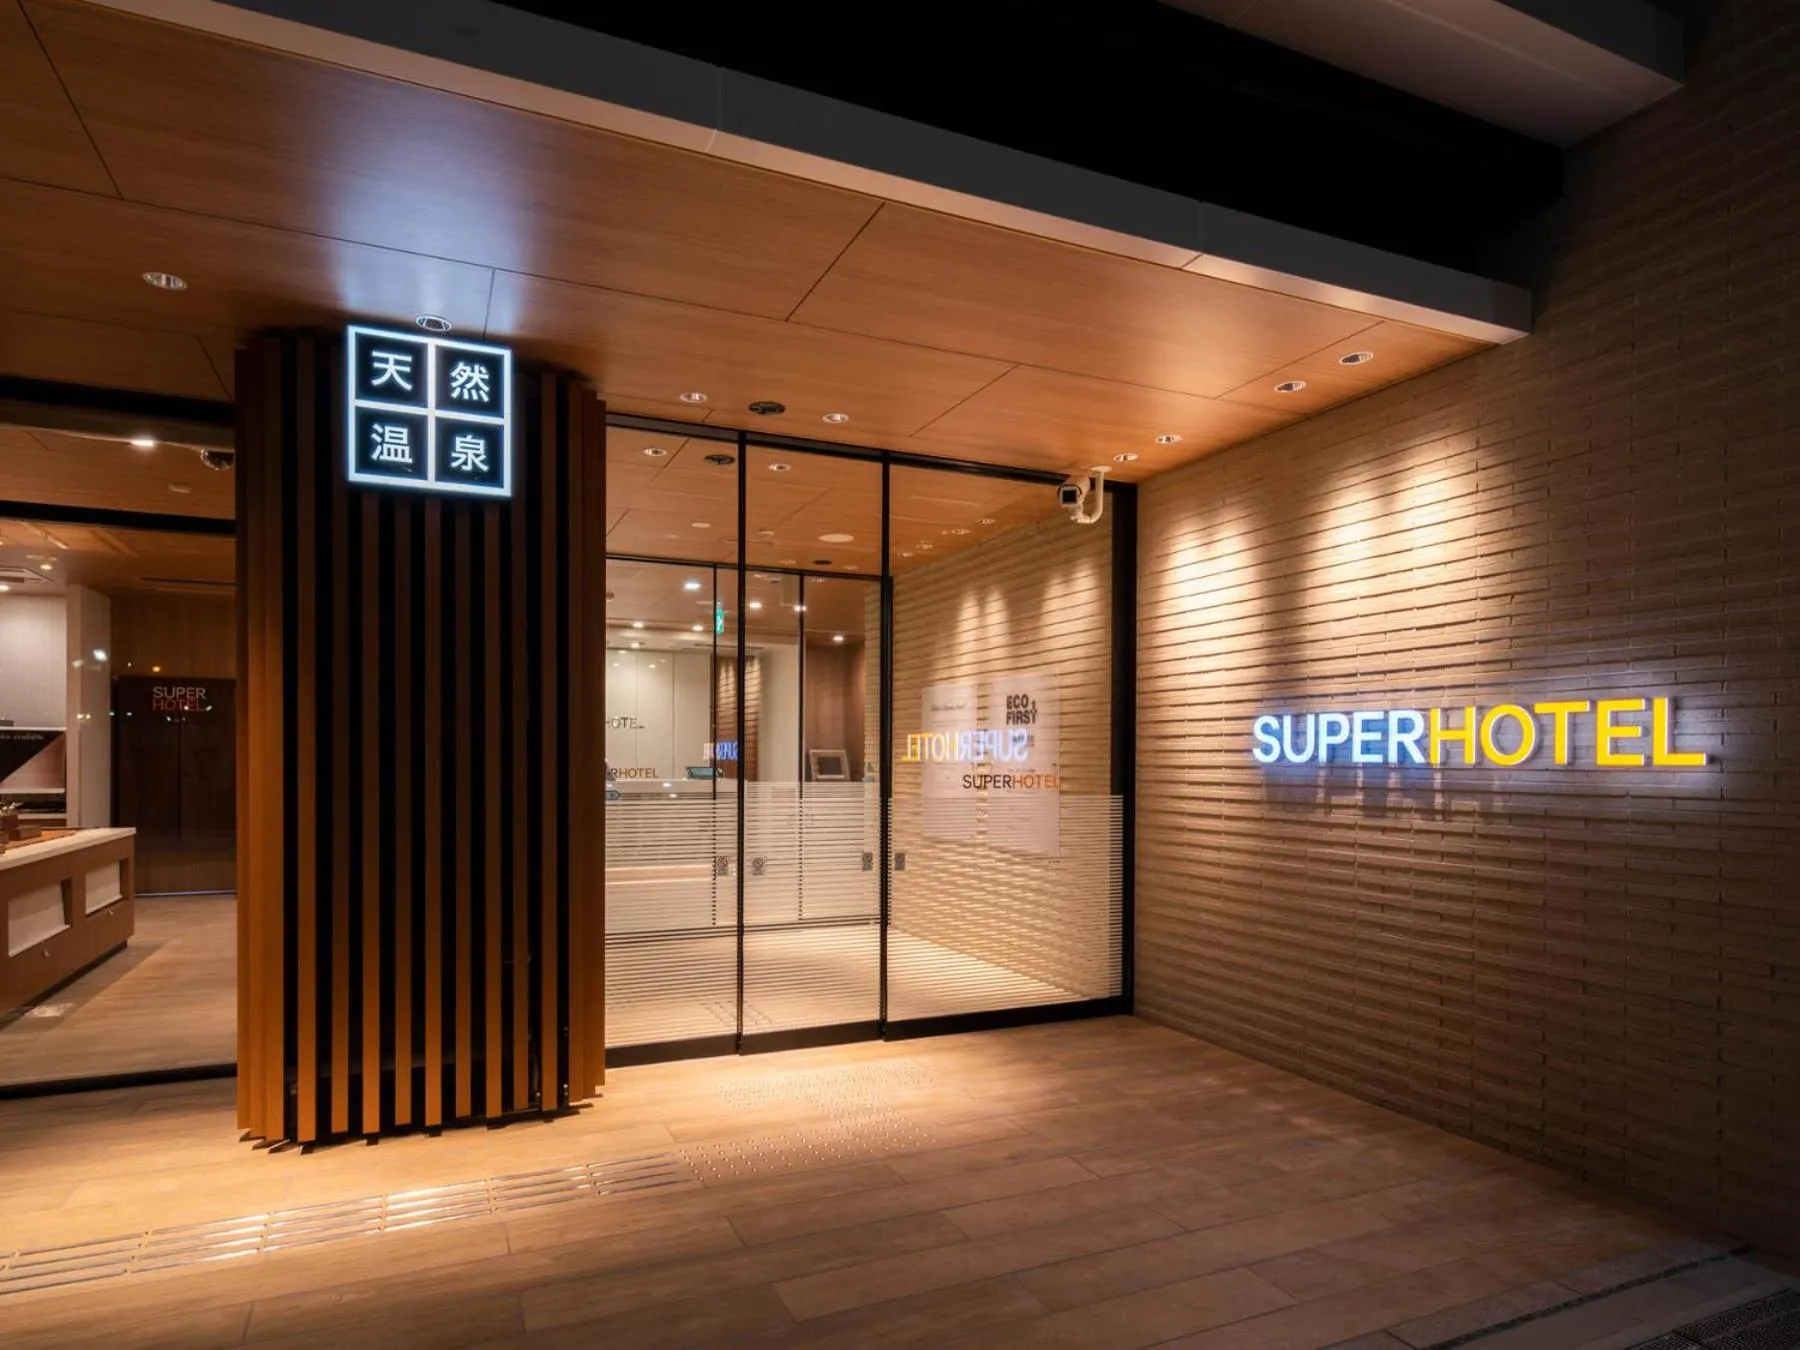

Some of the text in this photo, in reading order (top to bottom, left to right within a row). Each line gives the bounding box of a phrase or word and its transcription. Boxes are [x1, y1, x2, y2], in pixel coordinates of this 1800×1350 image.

[371, 350, 490, 402] 天然
[370, 423, 490, 472] 温泉
[152, 686, 207, 699] SUPER
[152, 699, 207, 712] HOTEL
[1006, 694, 1029, 710] ECO
[1006, 709, 1037, 725] FIRST
[1252, 696, 1707, 768] SUPERHOTEL
[962, 774, 1060, 789] SUPERHOTEL
